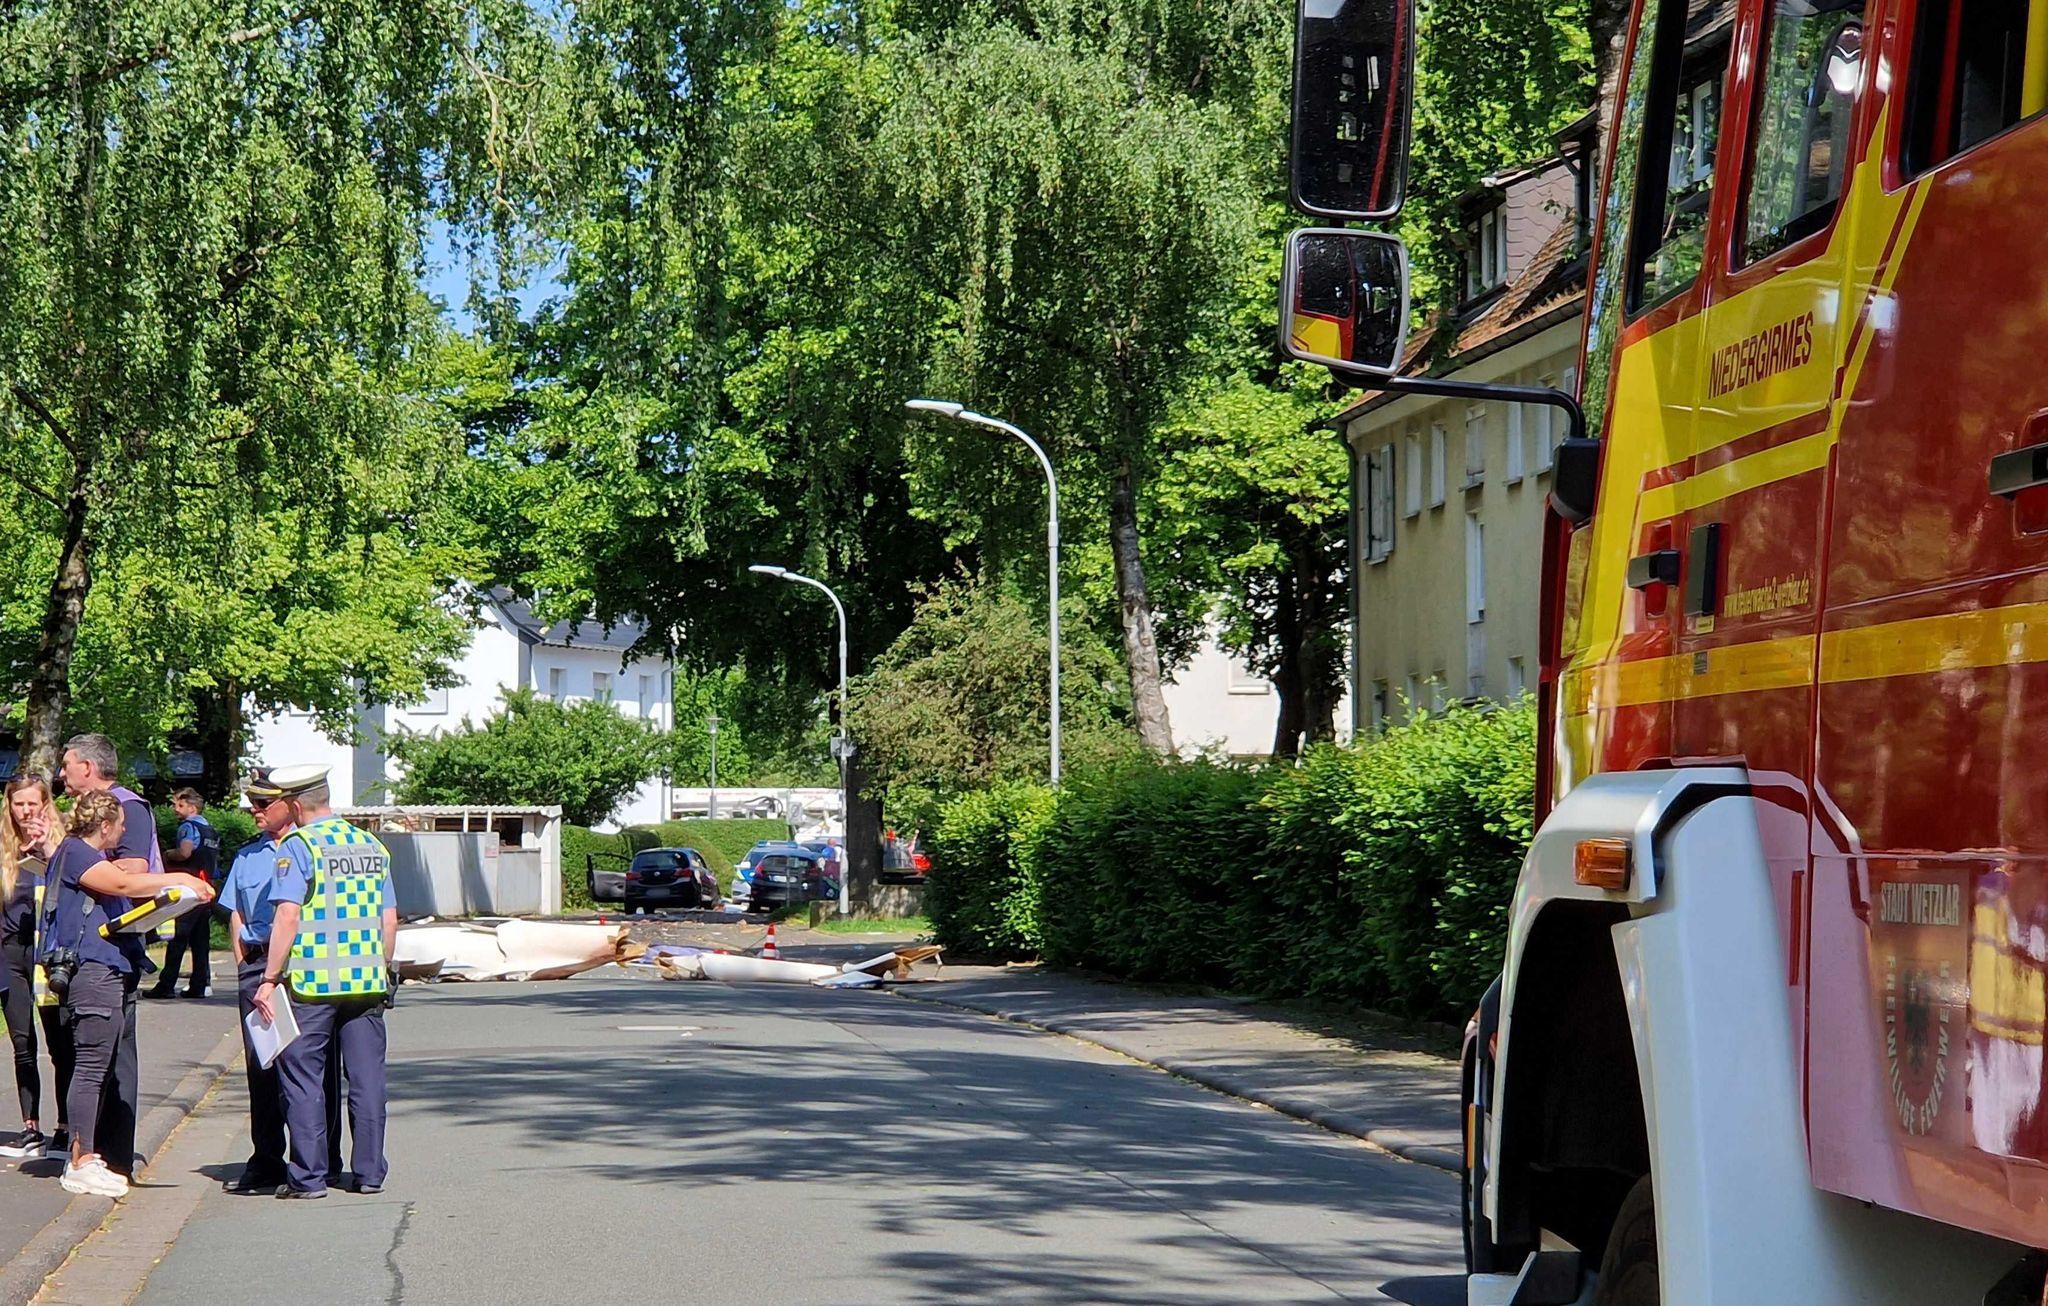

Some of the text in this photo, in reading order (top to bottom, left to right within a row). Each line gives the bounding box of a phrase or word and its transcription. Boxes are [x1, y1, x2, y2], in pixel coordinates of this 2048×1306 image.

[1708, 311, 1814, 400] NIEDERGIRMES
[1881, 882, 1960, 926] STADT WETZLAR
